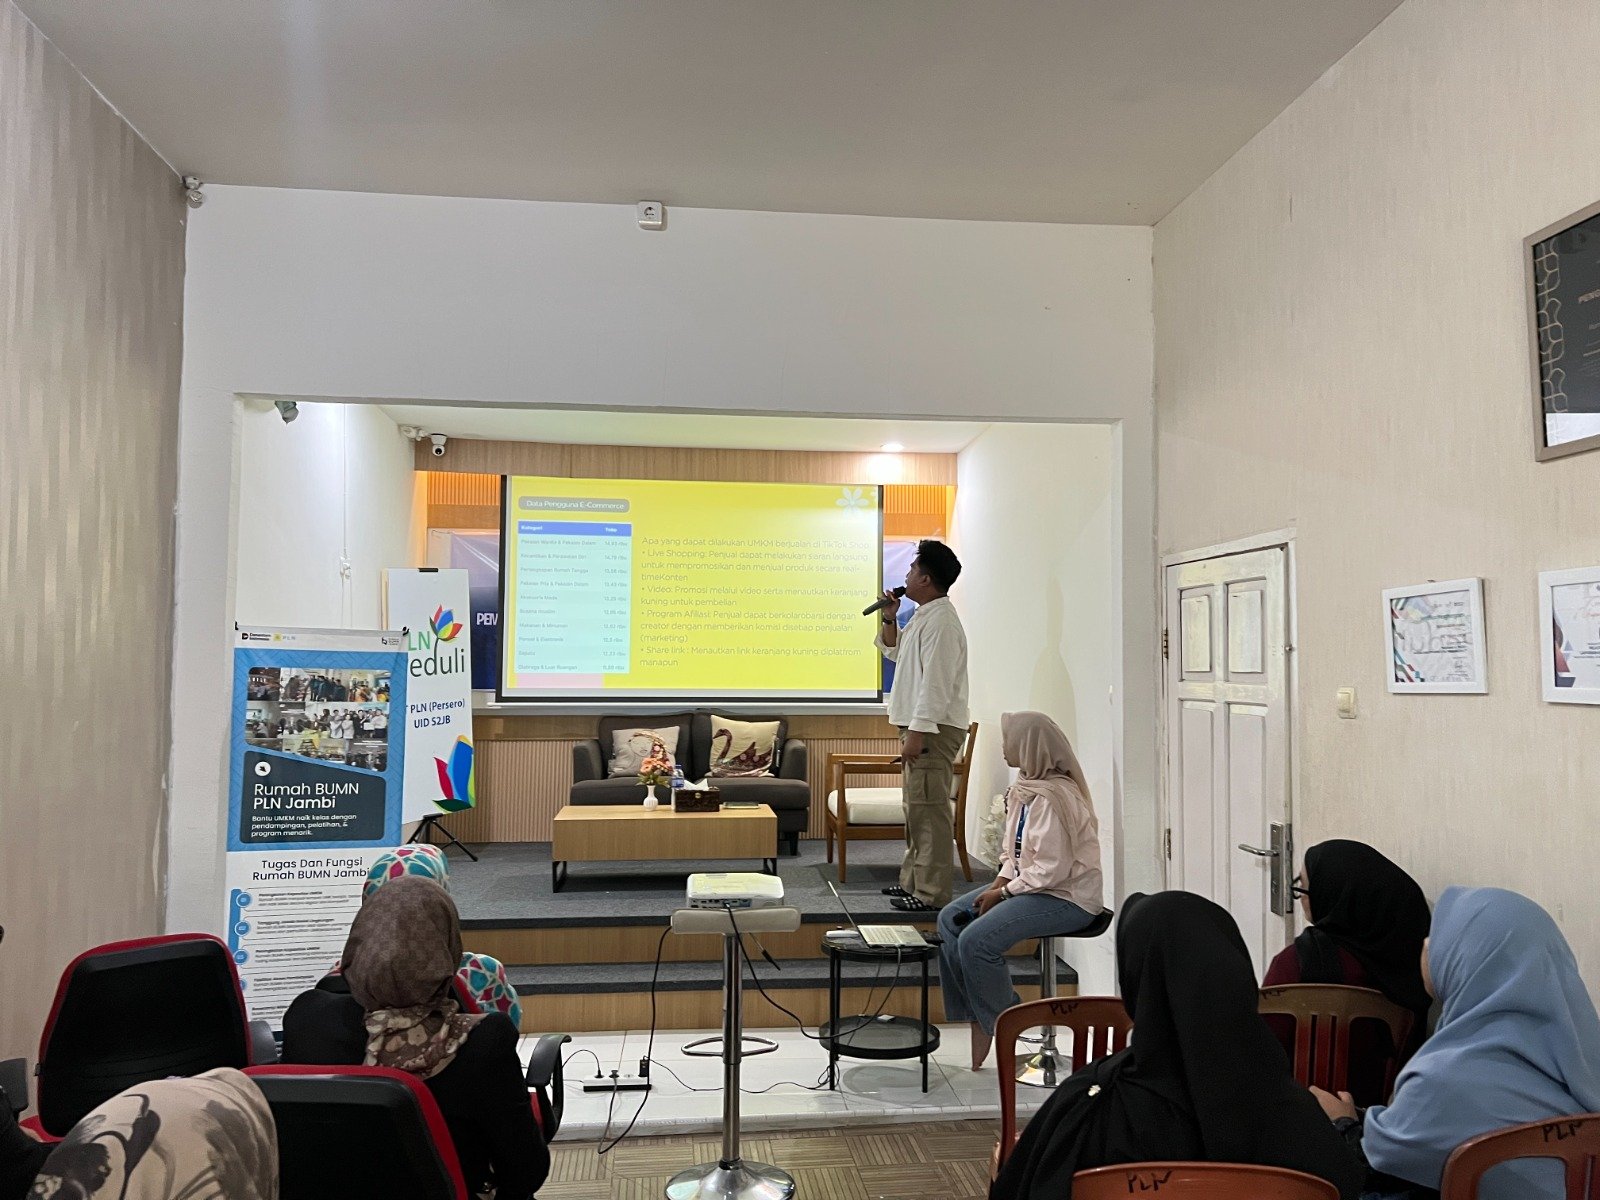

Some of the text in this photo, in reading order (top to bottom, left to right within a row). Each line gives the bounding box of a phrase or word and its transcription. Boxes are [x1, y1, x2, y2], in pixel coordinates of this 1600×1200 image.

[580, 502, 625, 510] E-Commerce
[642, 538, 659, 546] Apa
[682, 538, 705, 546] dapat
[708, 538, 745, 546] dilakukan
[776, 540, 811, 548] berjualan
[709, 550, 737, 559] Penjual
[833, 553, 868, 561] langsung
[831, 589, 868, 597] keranjang
[641, 598, 668, 606] kuning
[647, 610, 682, 618] Program
[714, 611, 742, 619] Penjual
[744, 612, 767, 620] dapat
[408, 631, 430, 650] LN
[640, 634, 688, 643] (marketing)
[410, 648, 465, 677] eduli
[410, 698, 465, 714] PLN (Persero)
[414, 715, 451, 728] UID S2JB
[254, 783, 359, 796] Rumah BUMN
[253, 796, 336, 809] PLN Jambi
[251, 822, 306, 830] pendampingan,
[262, 857, 363, 871] Tugas Dan Fungsi
[253, 868, 369, 880] Rumah BUMN Jambi
